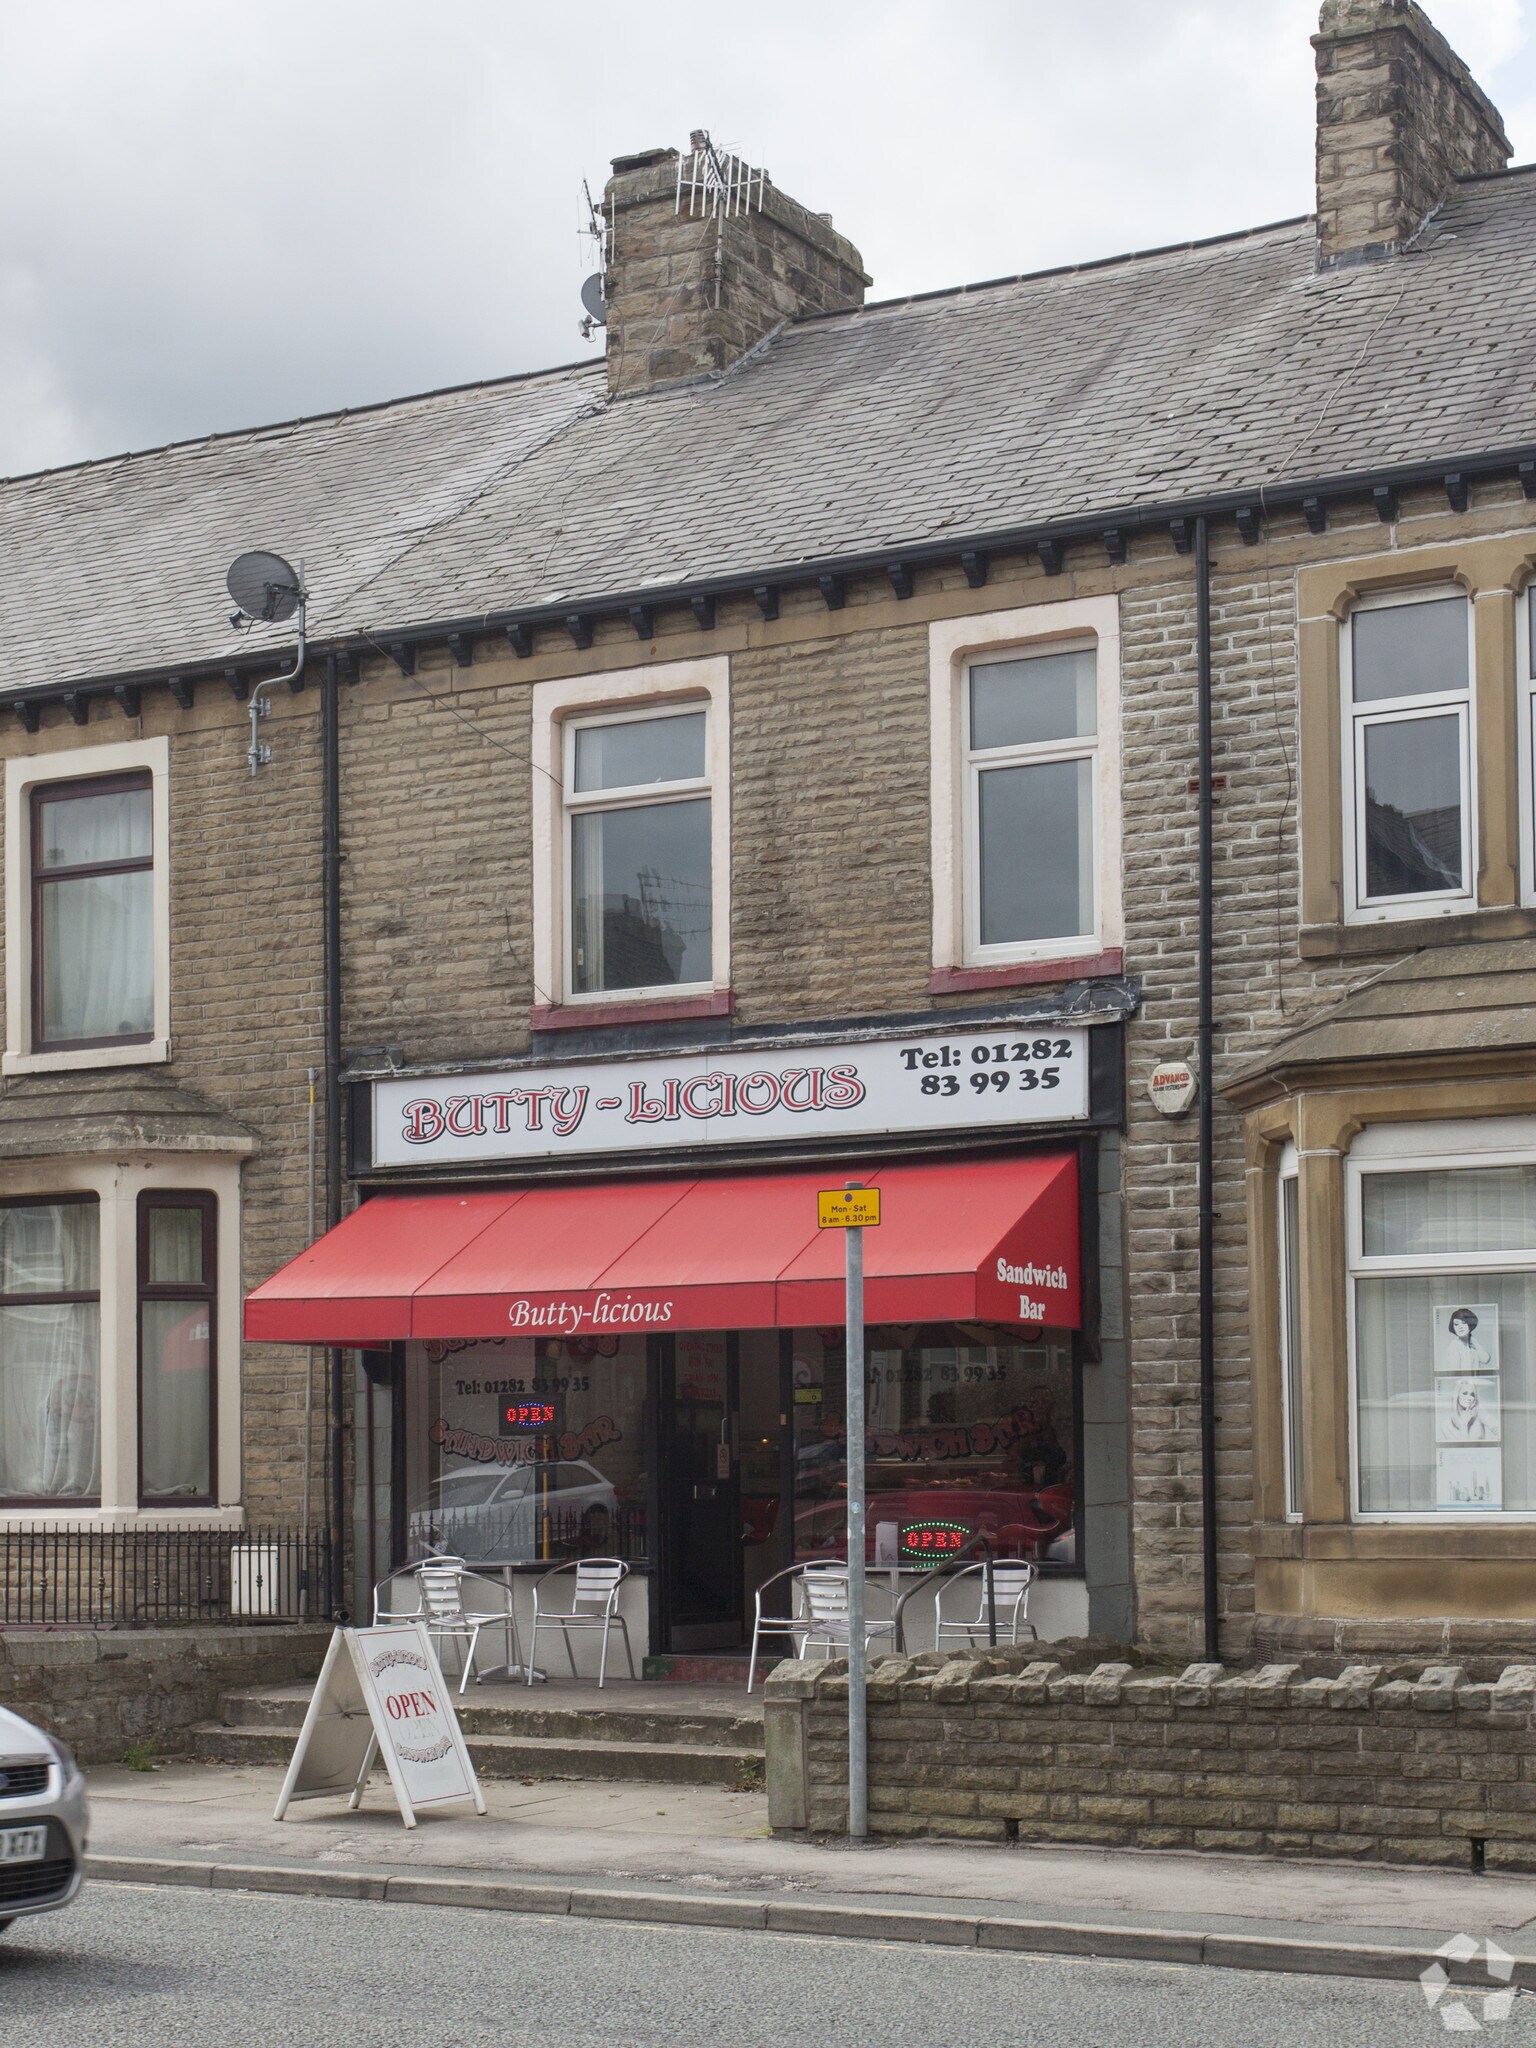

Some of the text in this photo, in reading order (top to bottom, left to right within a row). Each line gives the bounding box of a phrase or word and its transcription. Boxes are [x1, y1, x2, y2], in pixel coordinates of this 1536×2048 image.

[900, 1039, 1073, 1070] Tel: 01282
[920, 1066, 1060, 1097] 83 99 35
[831, 1205, 848, 1213] Mon
[853, 1204, 867, 1212] Sat
[997, 1257, 1068, 1290] Sandwich
[508, 1293, 673, 1334] Butty-licious
[1019, 1294, 1046, 1320] Bar
[456, 1380, 481, 1395] Tel:
[484, 1379, 525, 1394] 01282
[550, 1377, 570, 1392] 99
[572, 1376, 590, 1391] 35
[964, 1365, 984, 1383] 99
[506, 1406, 555, 1422] OPEN
[429, 1416, 623, 1467] SANDWICH BAR
[907, 1532, 963, 1548] OPEN
[386, 1690, 438, 1720] OPEN
